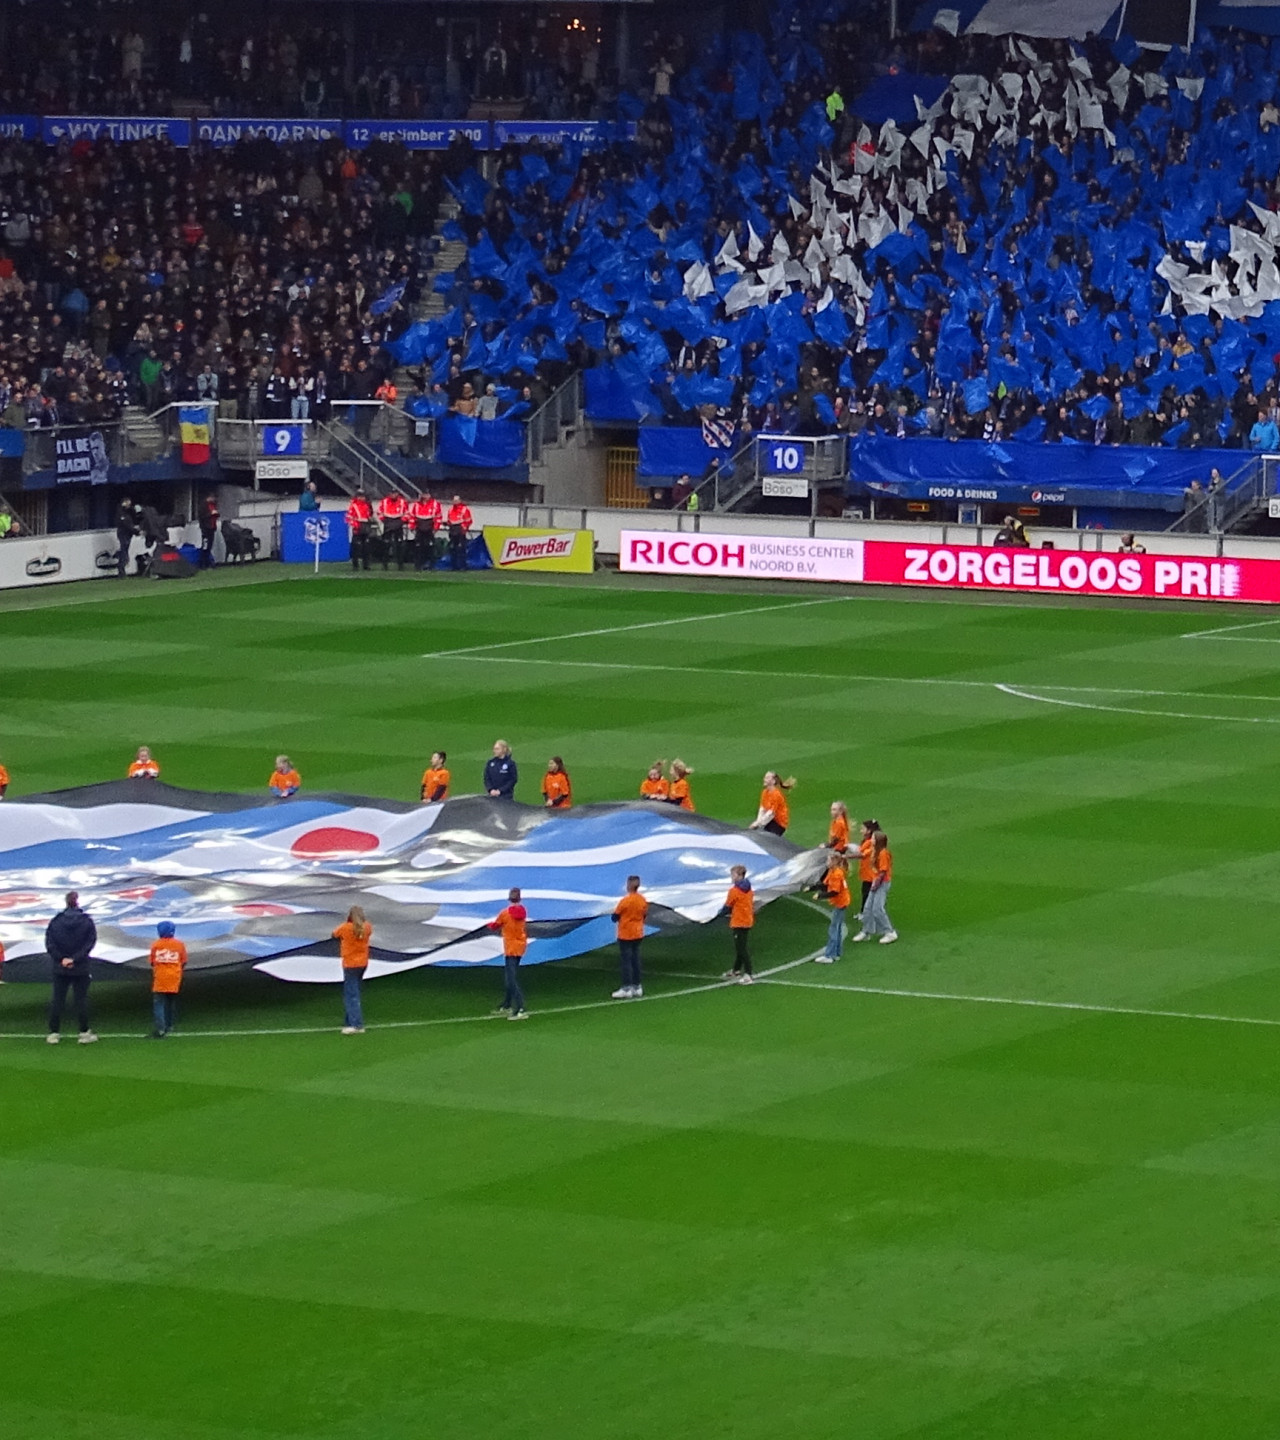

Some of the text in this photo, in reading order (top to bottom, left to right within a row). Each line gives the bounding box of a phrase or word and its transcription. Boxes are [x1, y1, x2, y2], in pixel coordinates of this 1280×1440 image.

[352, 129, 369, 141] 12
[448, 129, 482, 141] 200
[275, 430, 291, 452] 9
[773, 447, 798, 470] 10
[928, 487, 954, 499] FOOD
[964, 488, 998, 500] DRINKS
[507, 537, 572, 558] PowerBar
[630, 539, 854, 568] RICOH BUSINESS CENTER
[750, 559, 818, 573] NOORD B.V.
[904, 548, 1143, 592] ZORGELOOS
